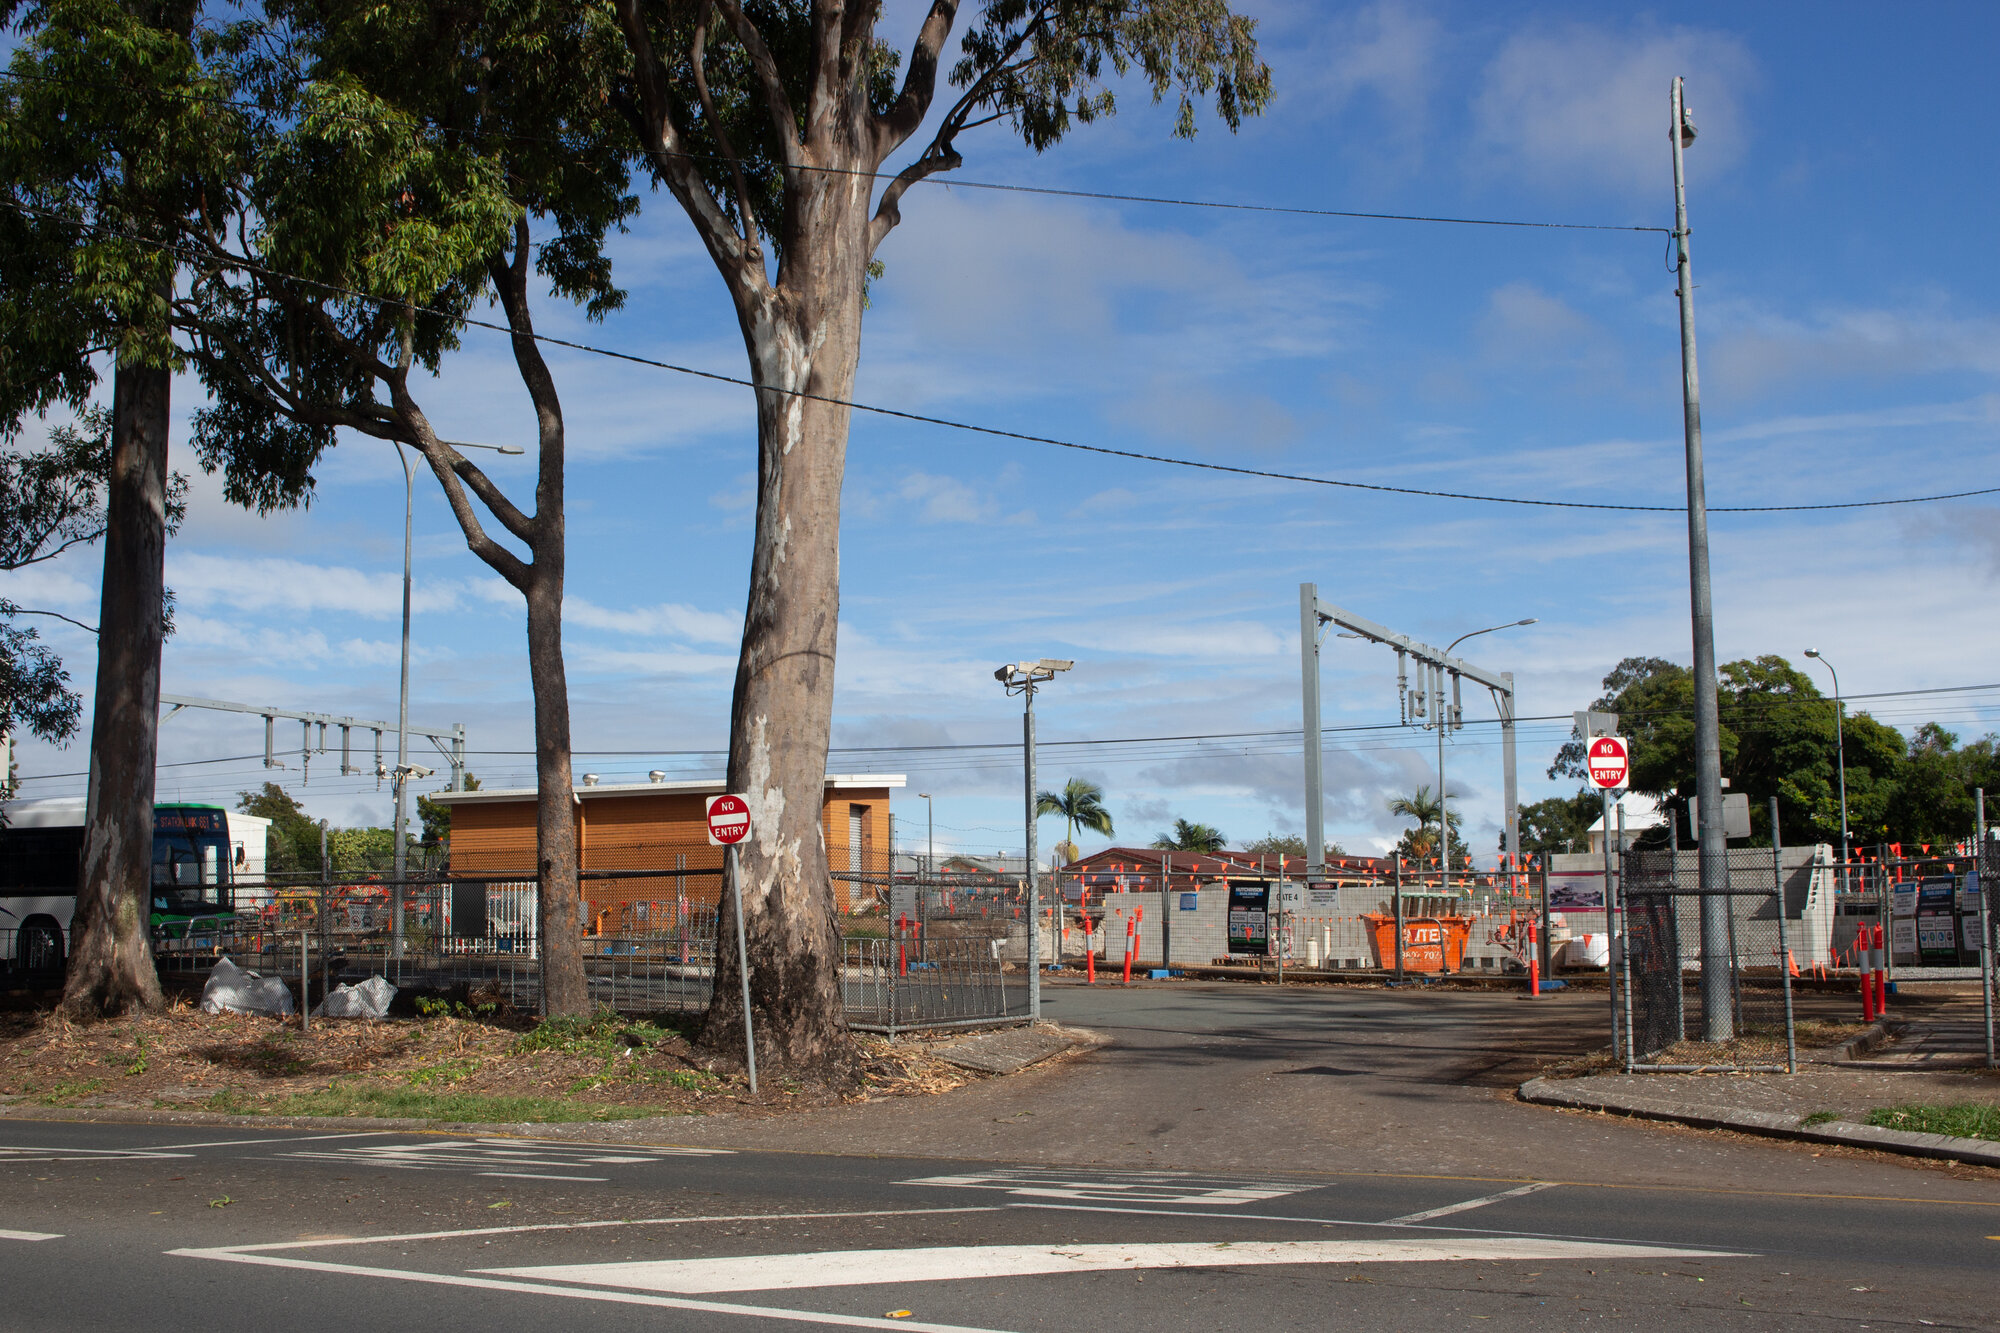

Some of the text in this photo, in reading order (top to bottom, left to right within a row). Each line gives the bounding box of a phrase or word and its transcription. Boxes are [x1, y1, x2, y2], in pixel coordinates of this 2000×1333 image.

[1601, 744, 1613, 754] NO
[1594, 770, 1622, 780] ENTRY
[721, 801, 735, 811] NO
[715, 826, 744, 838] ENTRY
[1293, 893, 1298, 901] 4
